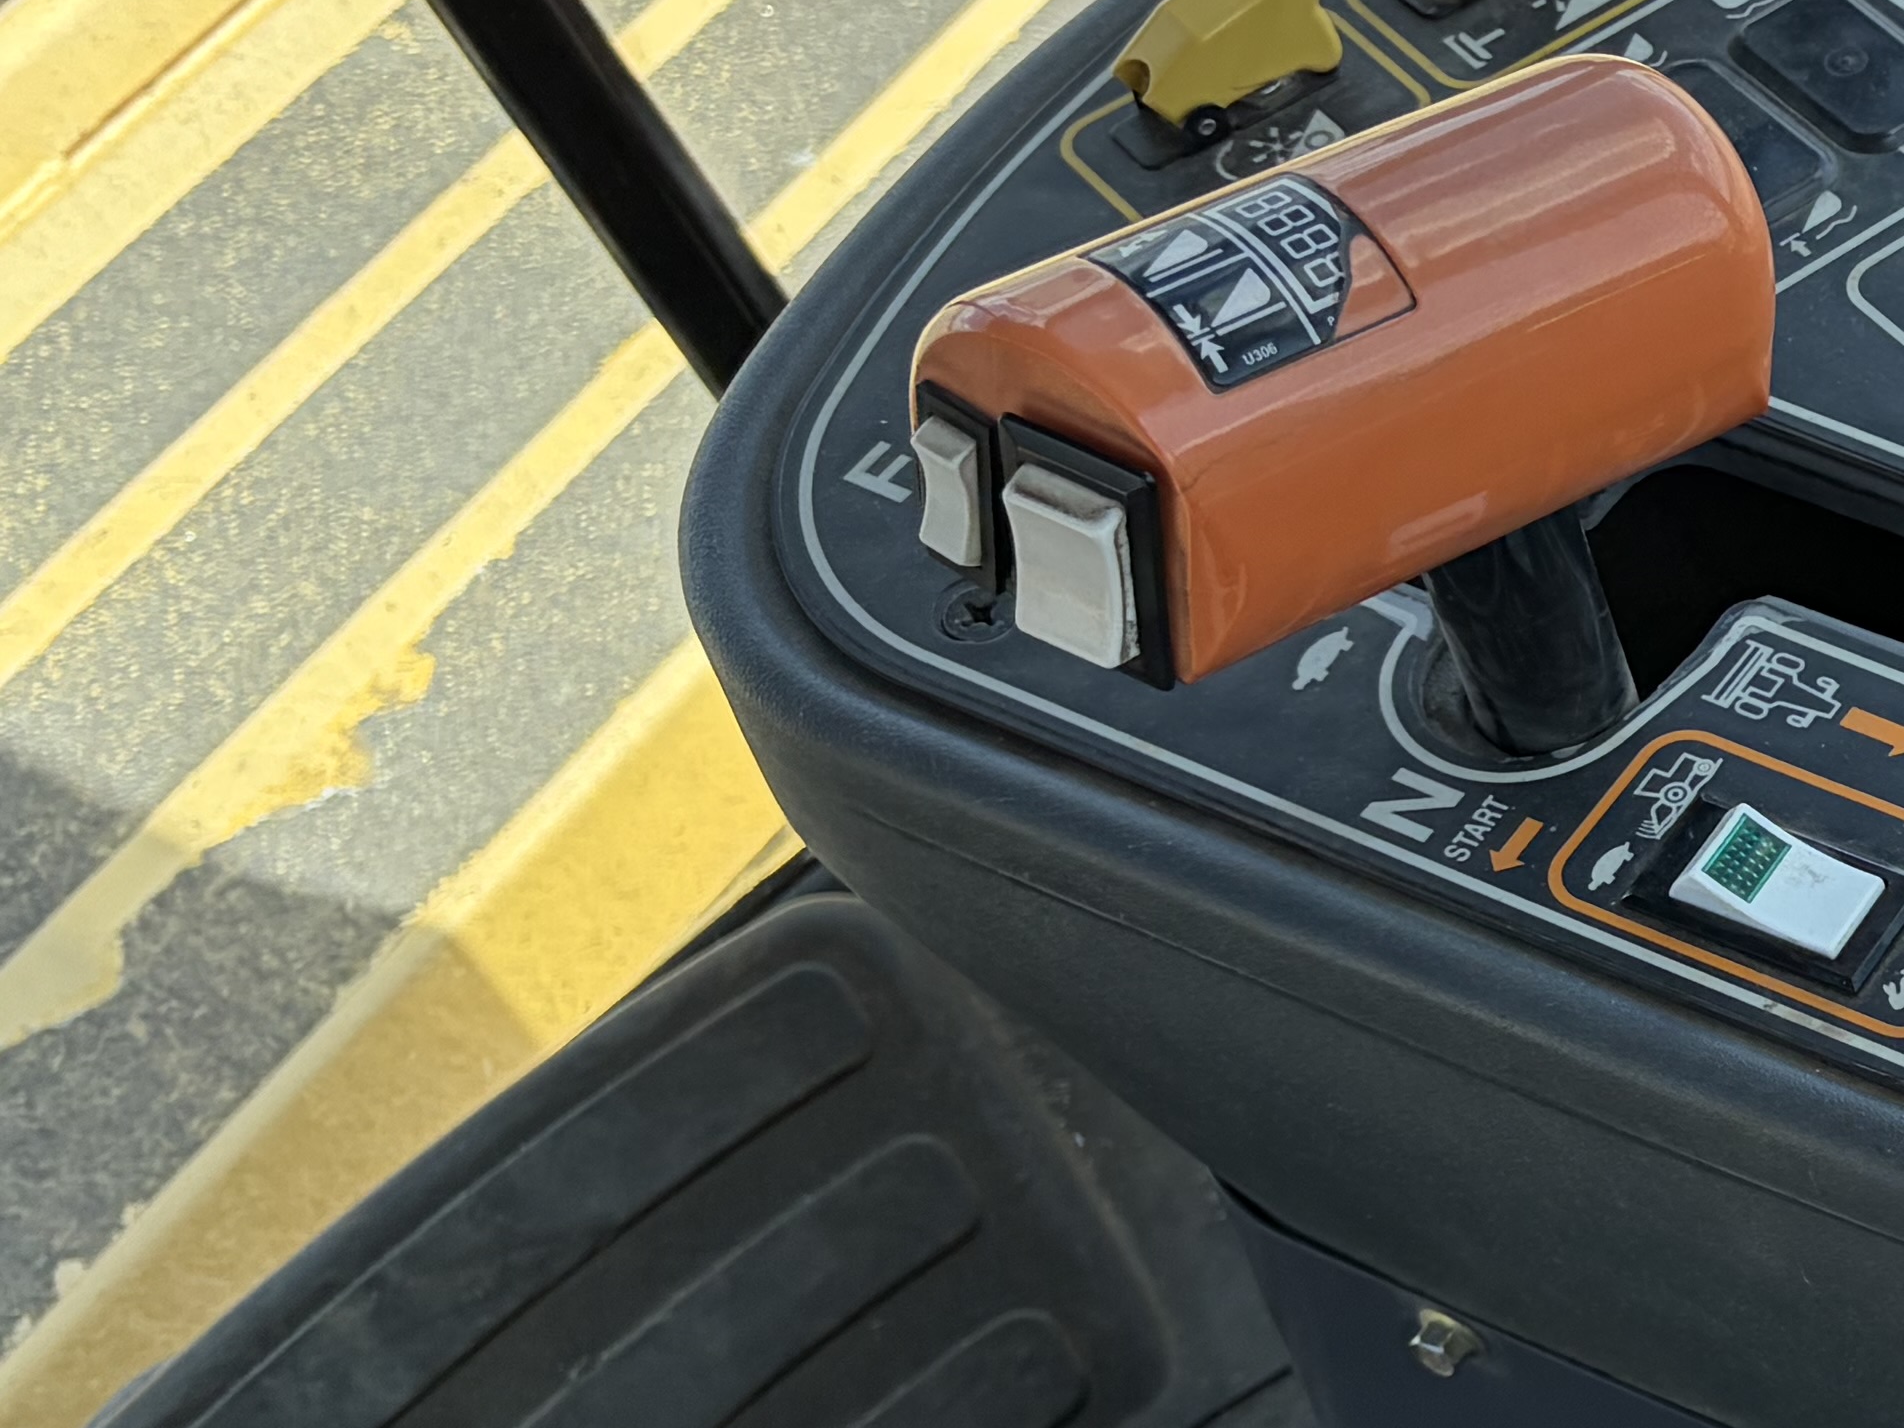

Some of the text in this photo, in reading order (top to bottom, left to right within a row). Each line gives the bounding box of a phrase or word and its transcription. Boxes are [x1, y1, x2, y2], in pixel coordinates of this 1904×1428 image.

[1242, 342, 1278, 366] U306
[843, 441, 913, 503] F
[1360, 767, 1465, 843] N
[1444, 794, 1510, 862] START
